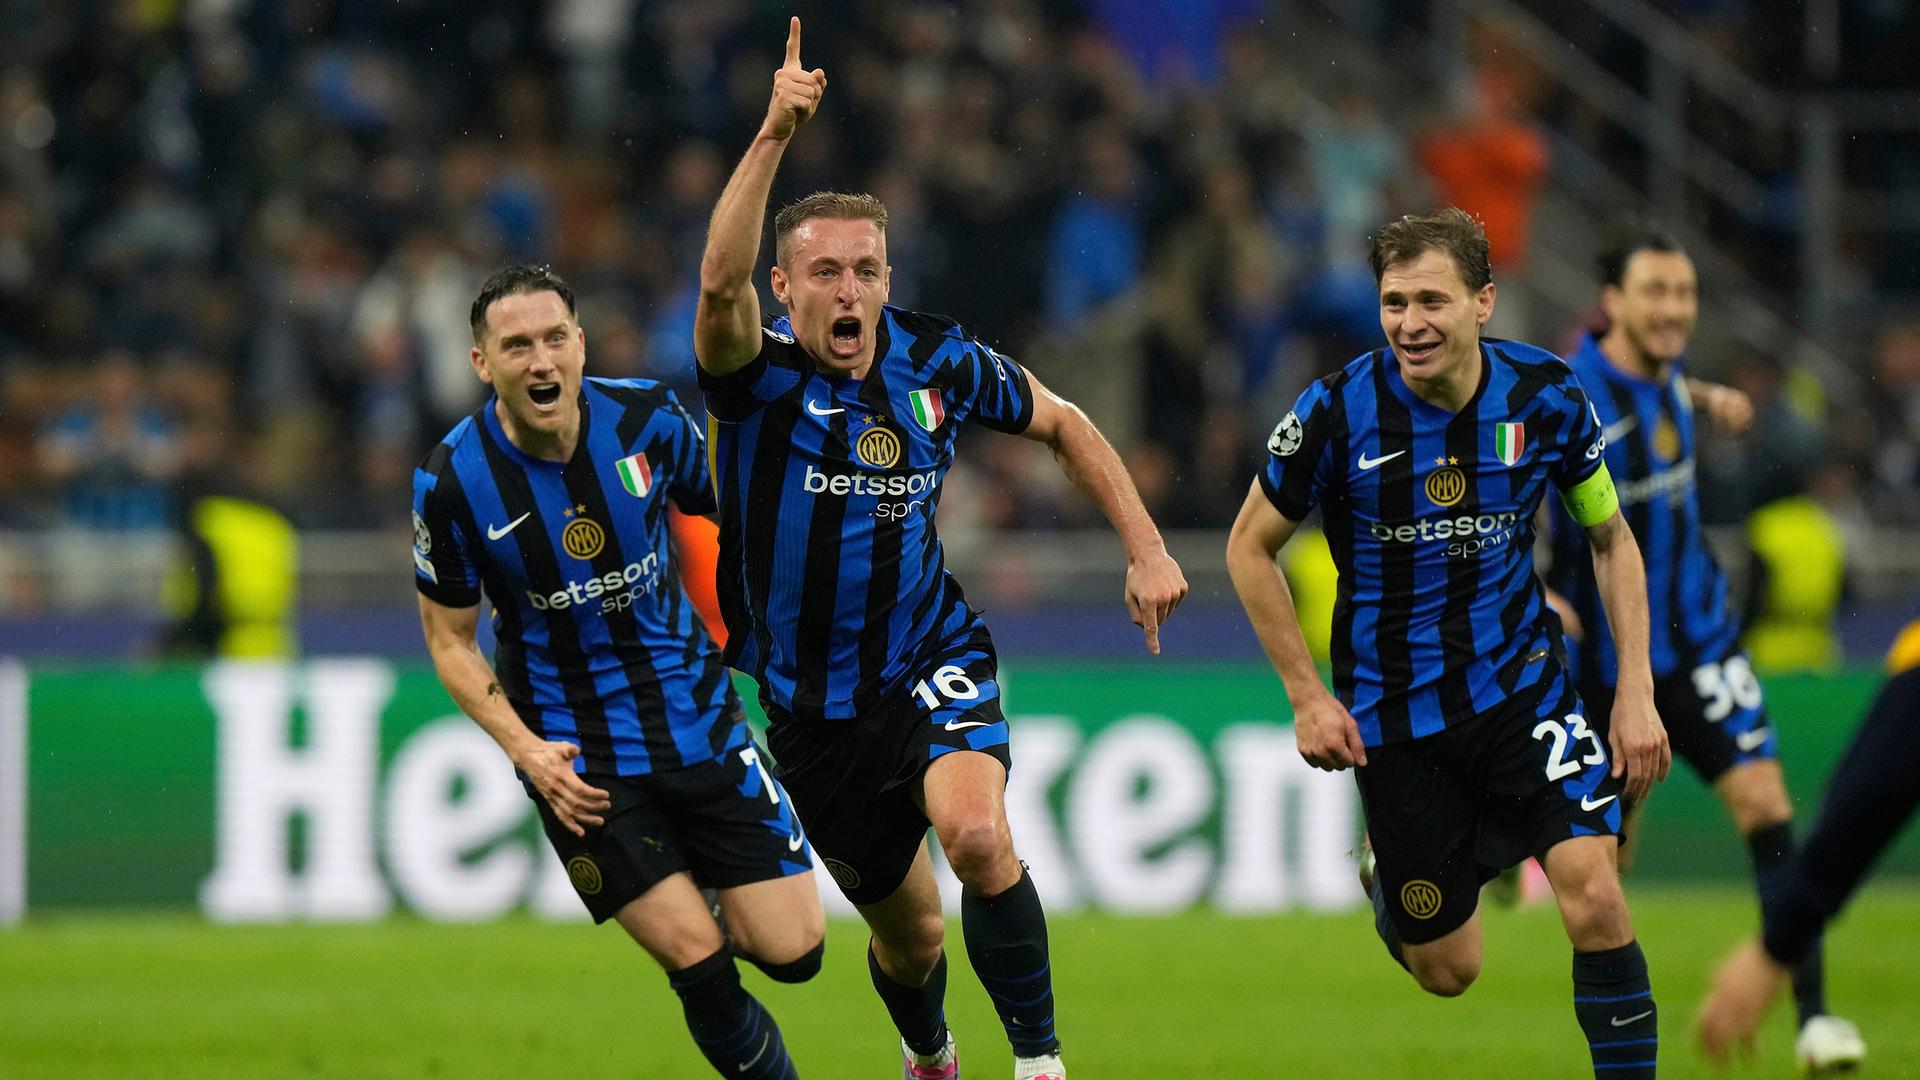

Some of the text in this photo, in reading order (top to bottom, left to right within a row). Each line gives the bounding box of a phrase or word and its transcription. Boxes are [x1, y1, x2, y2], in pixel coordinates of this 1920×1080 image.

[803, 465, 937, 496] betsson
[1371, 511, 1516, 543] betsson
[1440, 528, 1512, 559] .sport
[526, 551, 658, 611] betsson
[597, 572, 660, 617] .sport
[911, 665, 979, 711] 16
[1531, 713, 1605, 782] 23
[739, 747, 780, 804] 7
